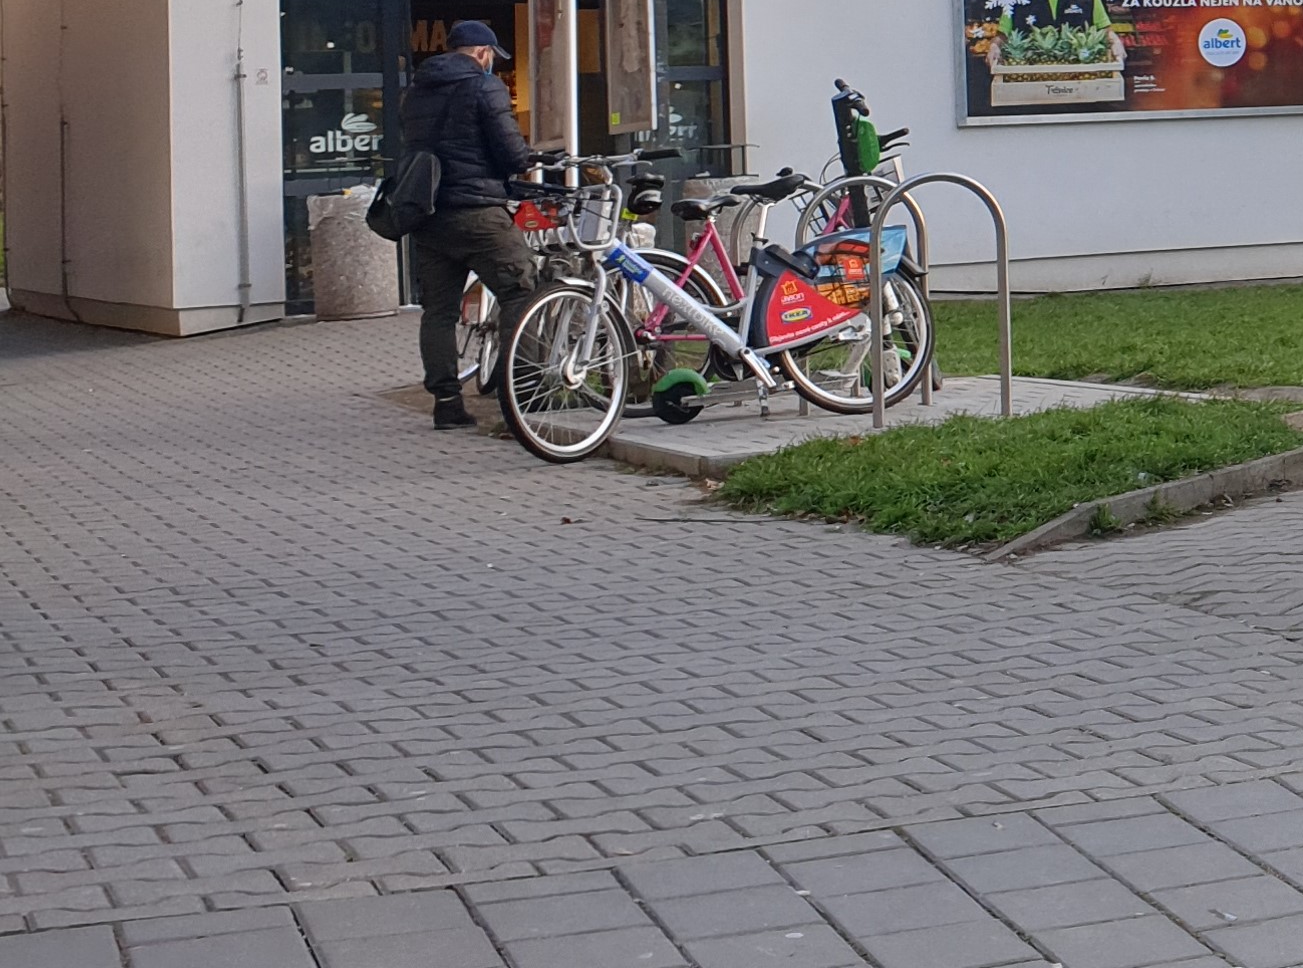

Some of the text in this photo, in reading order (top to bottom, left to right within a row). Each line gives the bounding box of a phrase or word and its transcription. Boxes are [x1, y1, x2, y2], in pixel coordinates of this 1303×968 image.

[1202, 37, 1242, 50] albert
[309, 130, 384, 154] alber
[660, 287, 726, 336] nextbike
